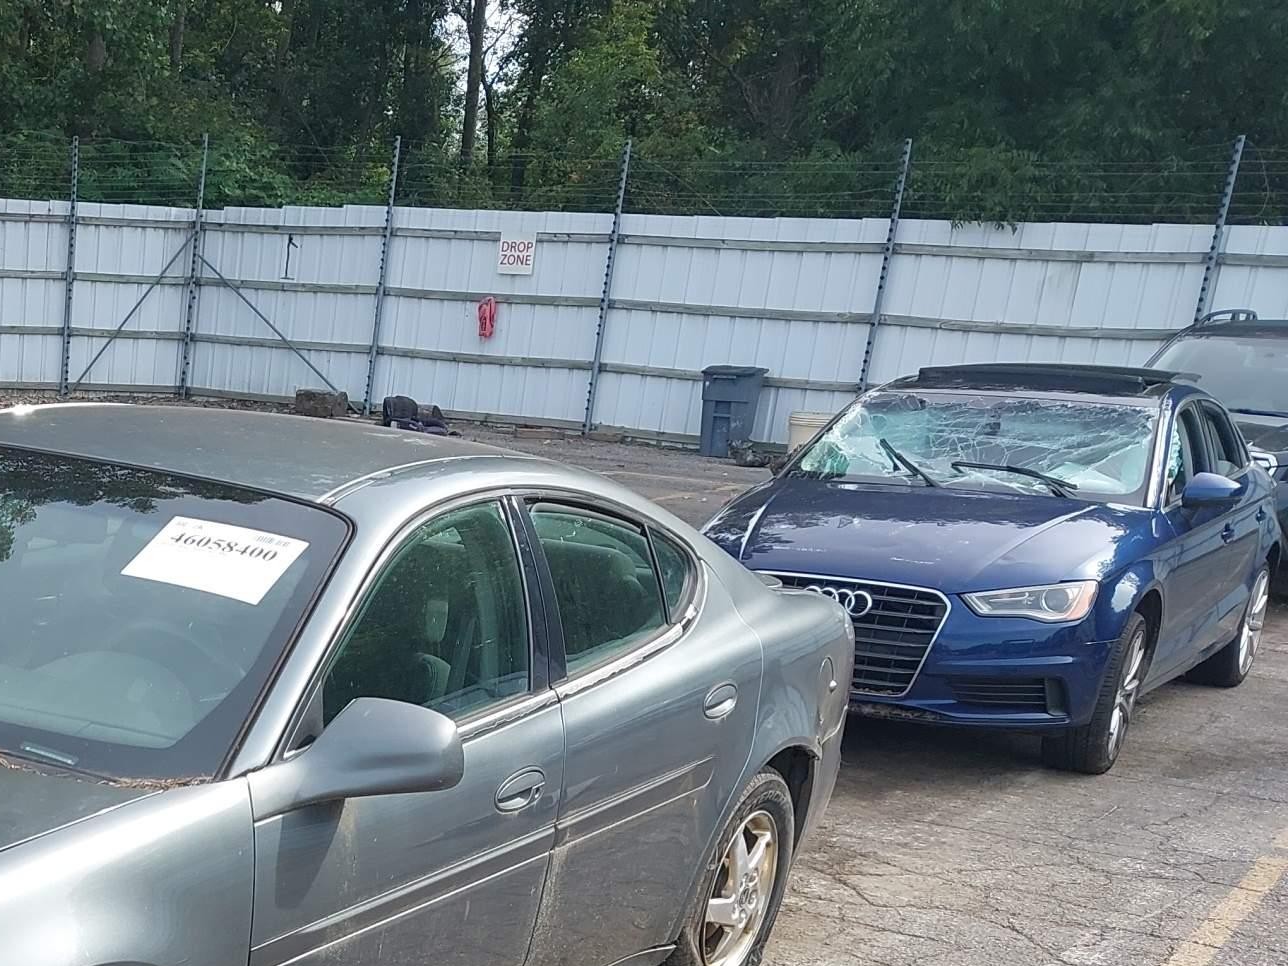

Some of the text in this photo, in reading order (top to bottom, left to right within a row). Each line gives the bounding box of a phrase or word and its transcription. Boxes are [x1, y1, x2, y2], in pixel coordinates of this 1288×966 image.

[501, 241, 533, 252] DROP
[500, 254, 531, 265] ZONE
[170, 531, 279, 562] 46058400
